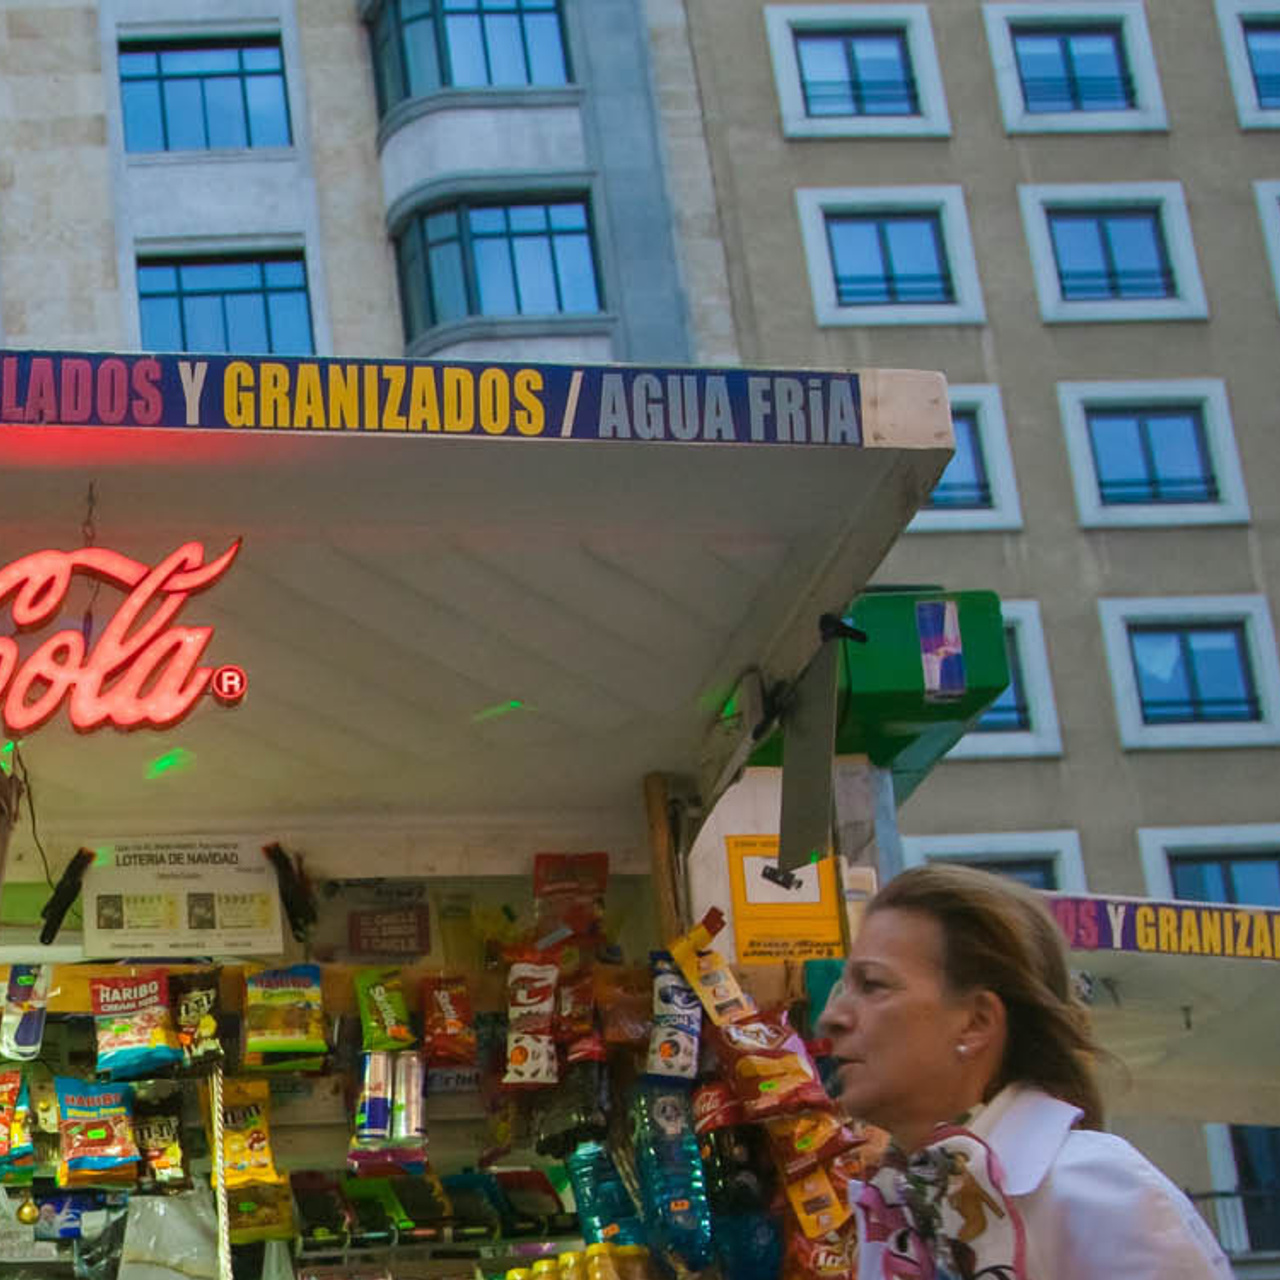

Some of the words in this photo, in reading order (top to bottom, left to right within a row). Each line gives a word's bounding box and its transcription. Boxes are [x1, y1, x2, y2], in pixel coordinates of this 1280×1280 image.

[179, 363, 205, 426] Y
[222, 361, 544, 437] GRANIZADOS
[598, 372, 734, 442] AGUA
[115, 852, 166, 867] LOTERIA
[169, 852, 184, 865] DE
[187, 851, 239, 865] NAVIDAD
[1107, 903, 1126, 949] Y
[100, 981, 159, 1003] HARIBO
